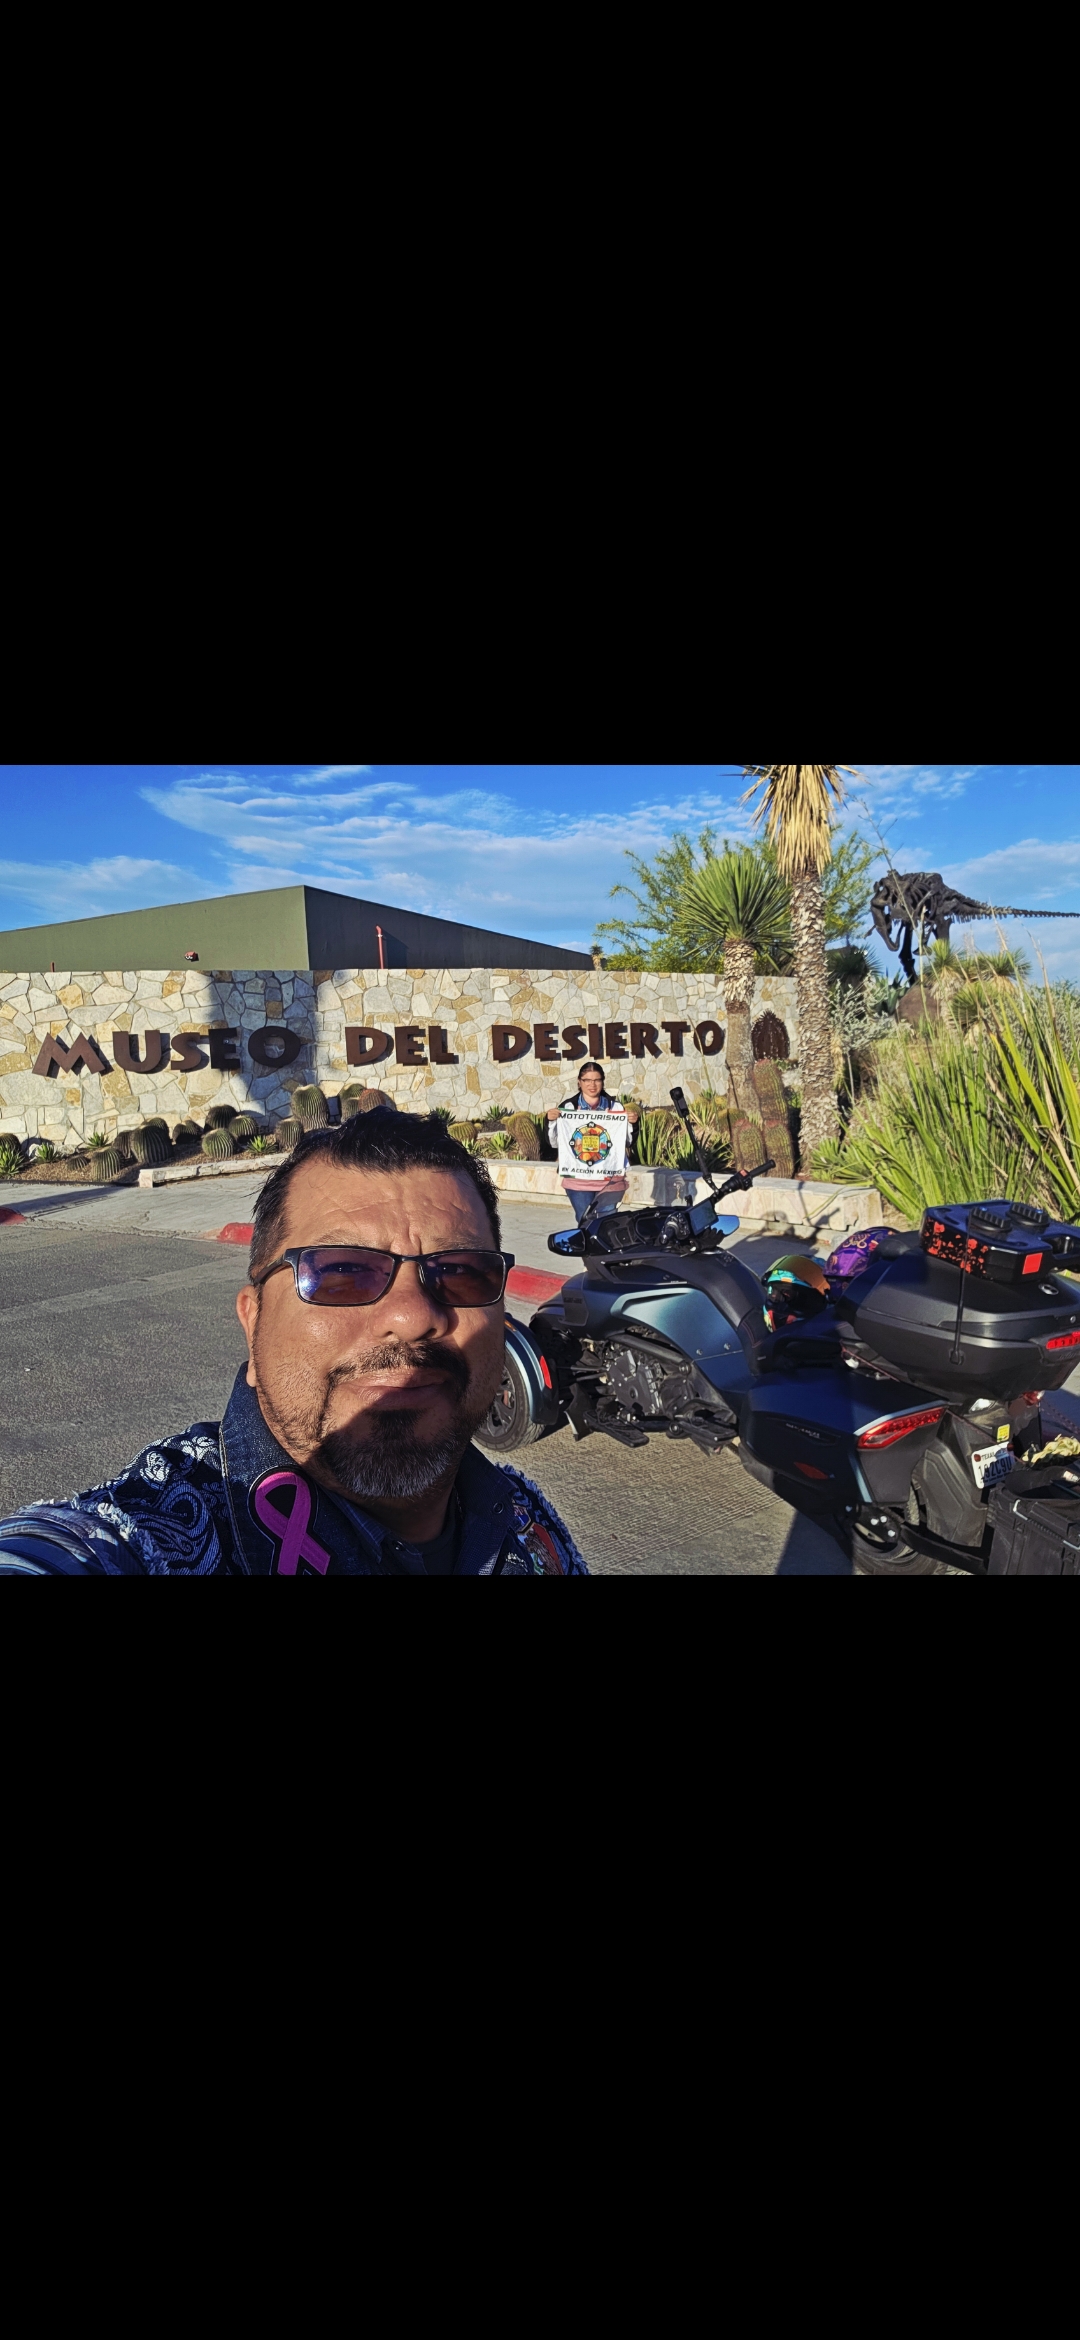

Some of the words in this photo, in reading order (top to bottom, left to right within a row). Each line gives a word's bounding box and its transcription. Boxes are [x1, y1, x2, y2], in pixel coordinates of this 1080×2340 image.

[32, 1026, 301, 1078] MUSEO
[345, 1025, 456, 1066] DEL
[492, 1020, 725, 1062] DESIERTO
[559, 1113, 626, 1121] MOTOTURISMO
